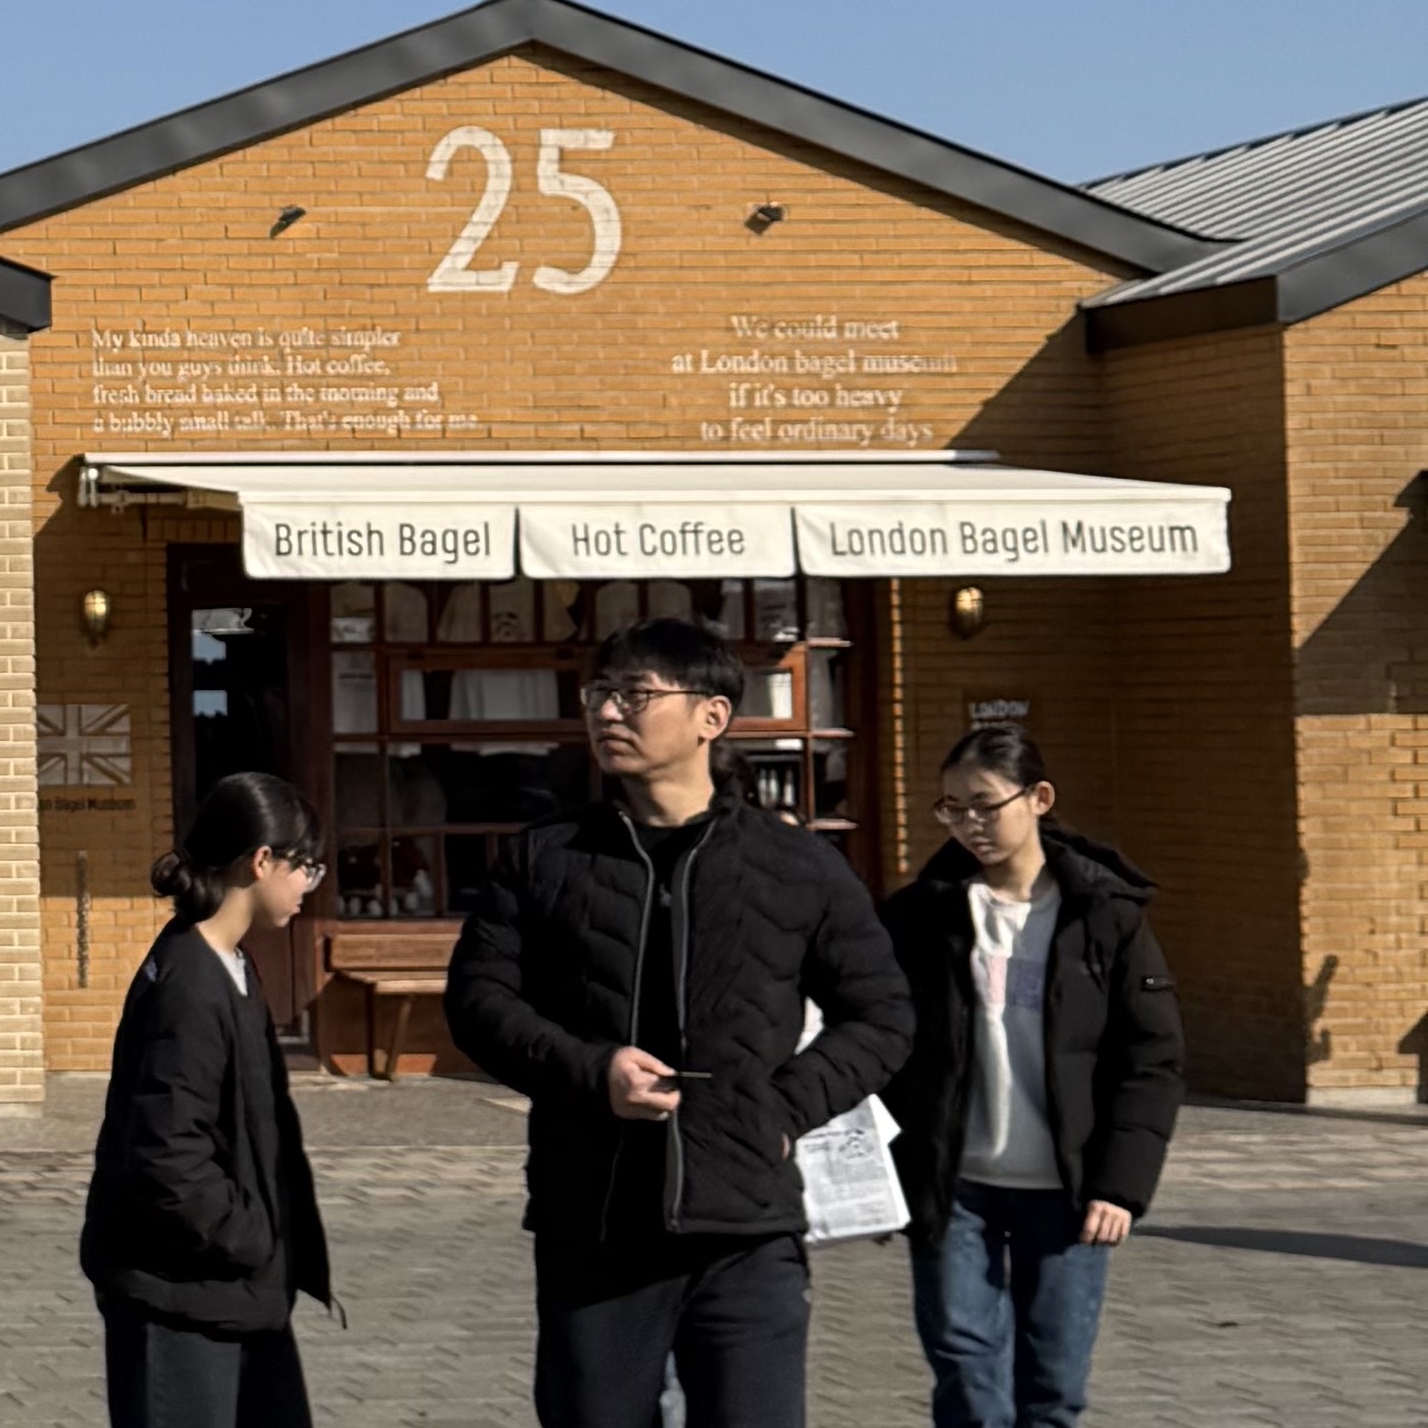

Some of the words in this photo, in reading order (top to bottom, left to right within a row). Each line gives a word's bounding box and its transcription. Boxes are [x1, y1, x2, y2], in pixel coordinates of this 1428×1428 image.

[425, 125, 622, 295] 25
[91, 328, 123, 353] My
[127, 328, 181, 348] kinda
[185, 328, 253, 348] heaven
[257, 328, 274, 347] is
[330, 327, 402, 353] simpler
[730, 315, 769, 340] We
[773, 314, 837, 340] could
[844, 320, 900, 340] meet
[92, 357, 133, 377] than
[136, 361, 173, 381] you
[177, 361, 222, 382] guys
[286, 356, 322, 376] Hot
[671, 353, 694, 373] at
[700, 349, 788, 374] London
[795, 349, 856, 380] bagel
[93, 384, 140, 404] fresh
[144, 384, 197, 404] bread
[201, 384, 258, 403] baked
[262, 385, 282, 403] in
[286, 384, 315, 403] the
[319, 384, 398, 409] morning
[402, 382, 439, 403] and
[729, 382, 751, 408] if
[792, 387, 829, 408] too
[835, 383, 903, 413] heavy
[109, 412, 174, 439] bubbly
[180, 412, 229, 432] small
[341, 410, 410, 437] enough
[414, 410, 443, 431] for
[700, 420, 723, 442] to
[730, 416, 772, 442] feel
[777, 417, 873, 447] ordinary
[880, 417, 933, 447] days
[275, 521, 385, 557] British
[398, 521, 490, 565] Bagel
[571, 522, 629, 557] Hot
[639, 520, 746, 557] Coffee
[830, 520, 947, 556] London
[959, 519, 1049, 563] Bagel
[1061, 519, 1199, 554] Museum
